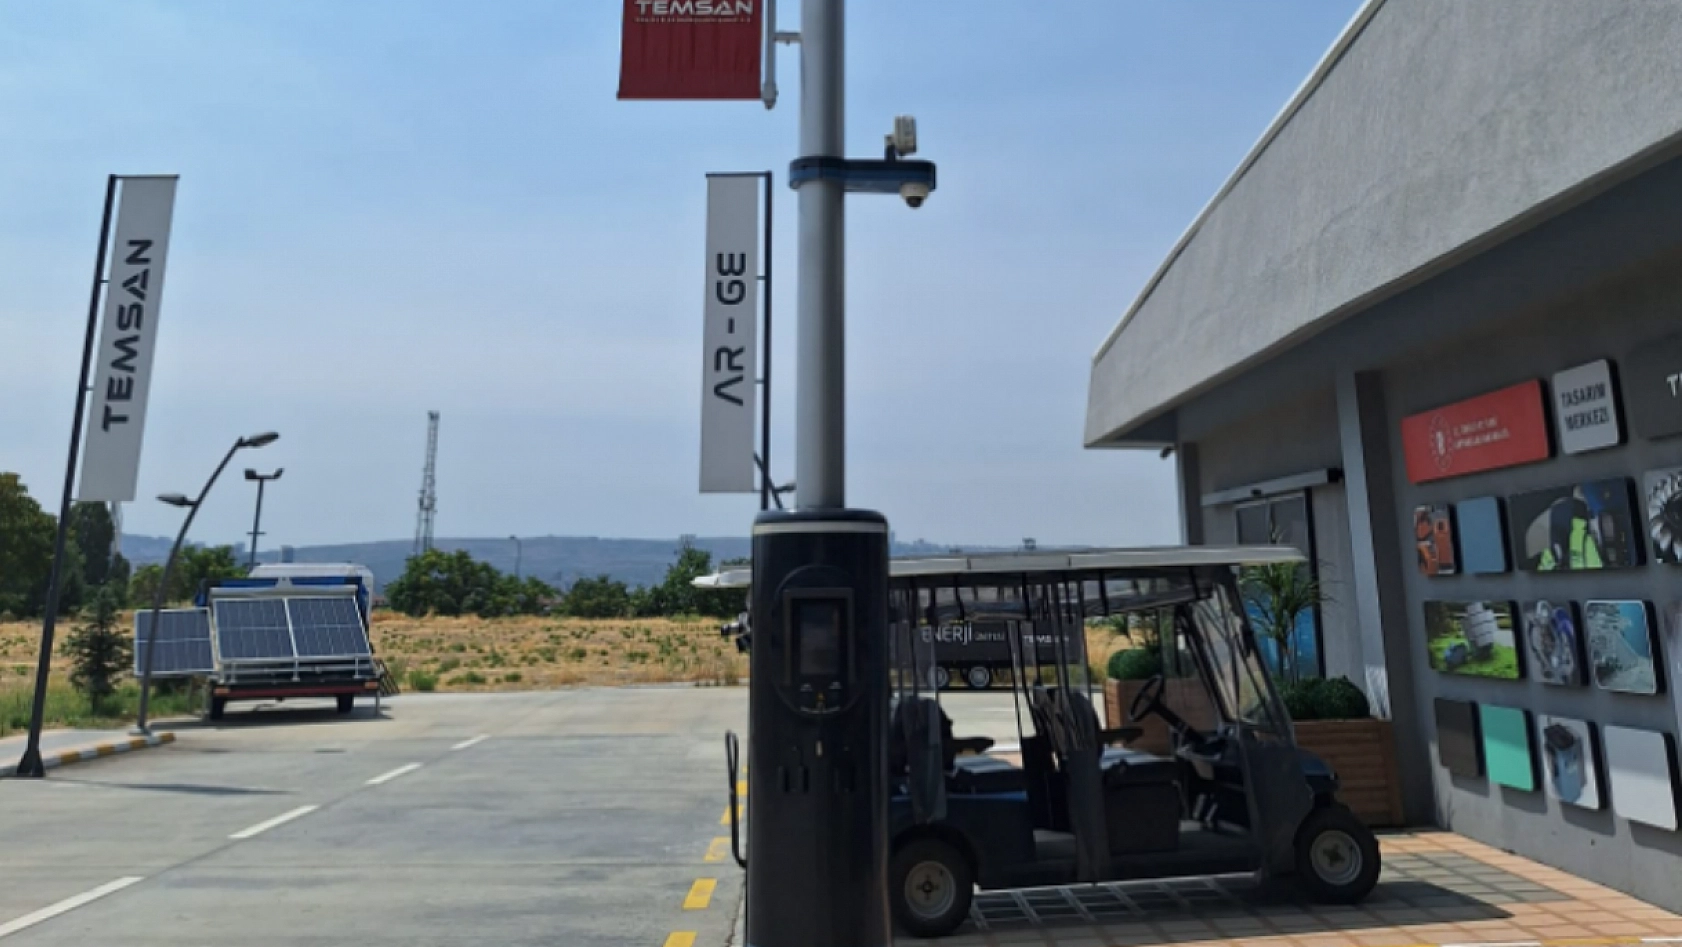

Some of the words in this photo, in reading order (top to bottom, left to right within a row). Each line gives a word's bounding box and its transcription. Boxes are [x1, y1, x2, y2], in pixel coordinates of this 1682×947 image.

[634, 0, 754, 16] TEMSAN
[716, 253, 747, 306] GE
[102, 238, 154, 433] TEMSAN
[714, 346, 745, 407] AR
